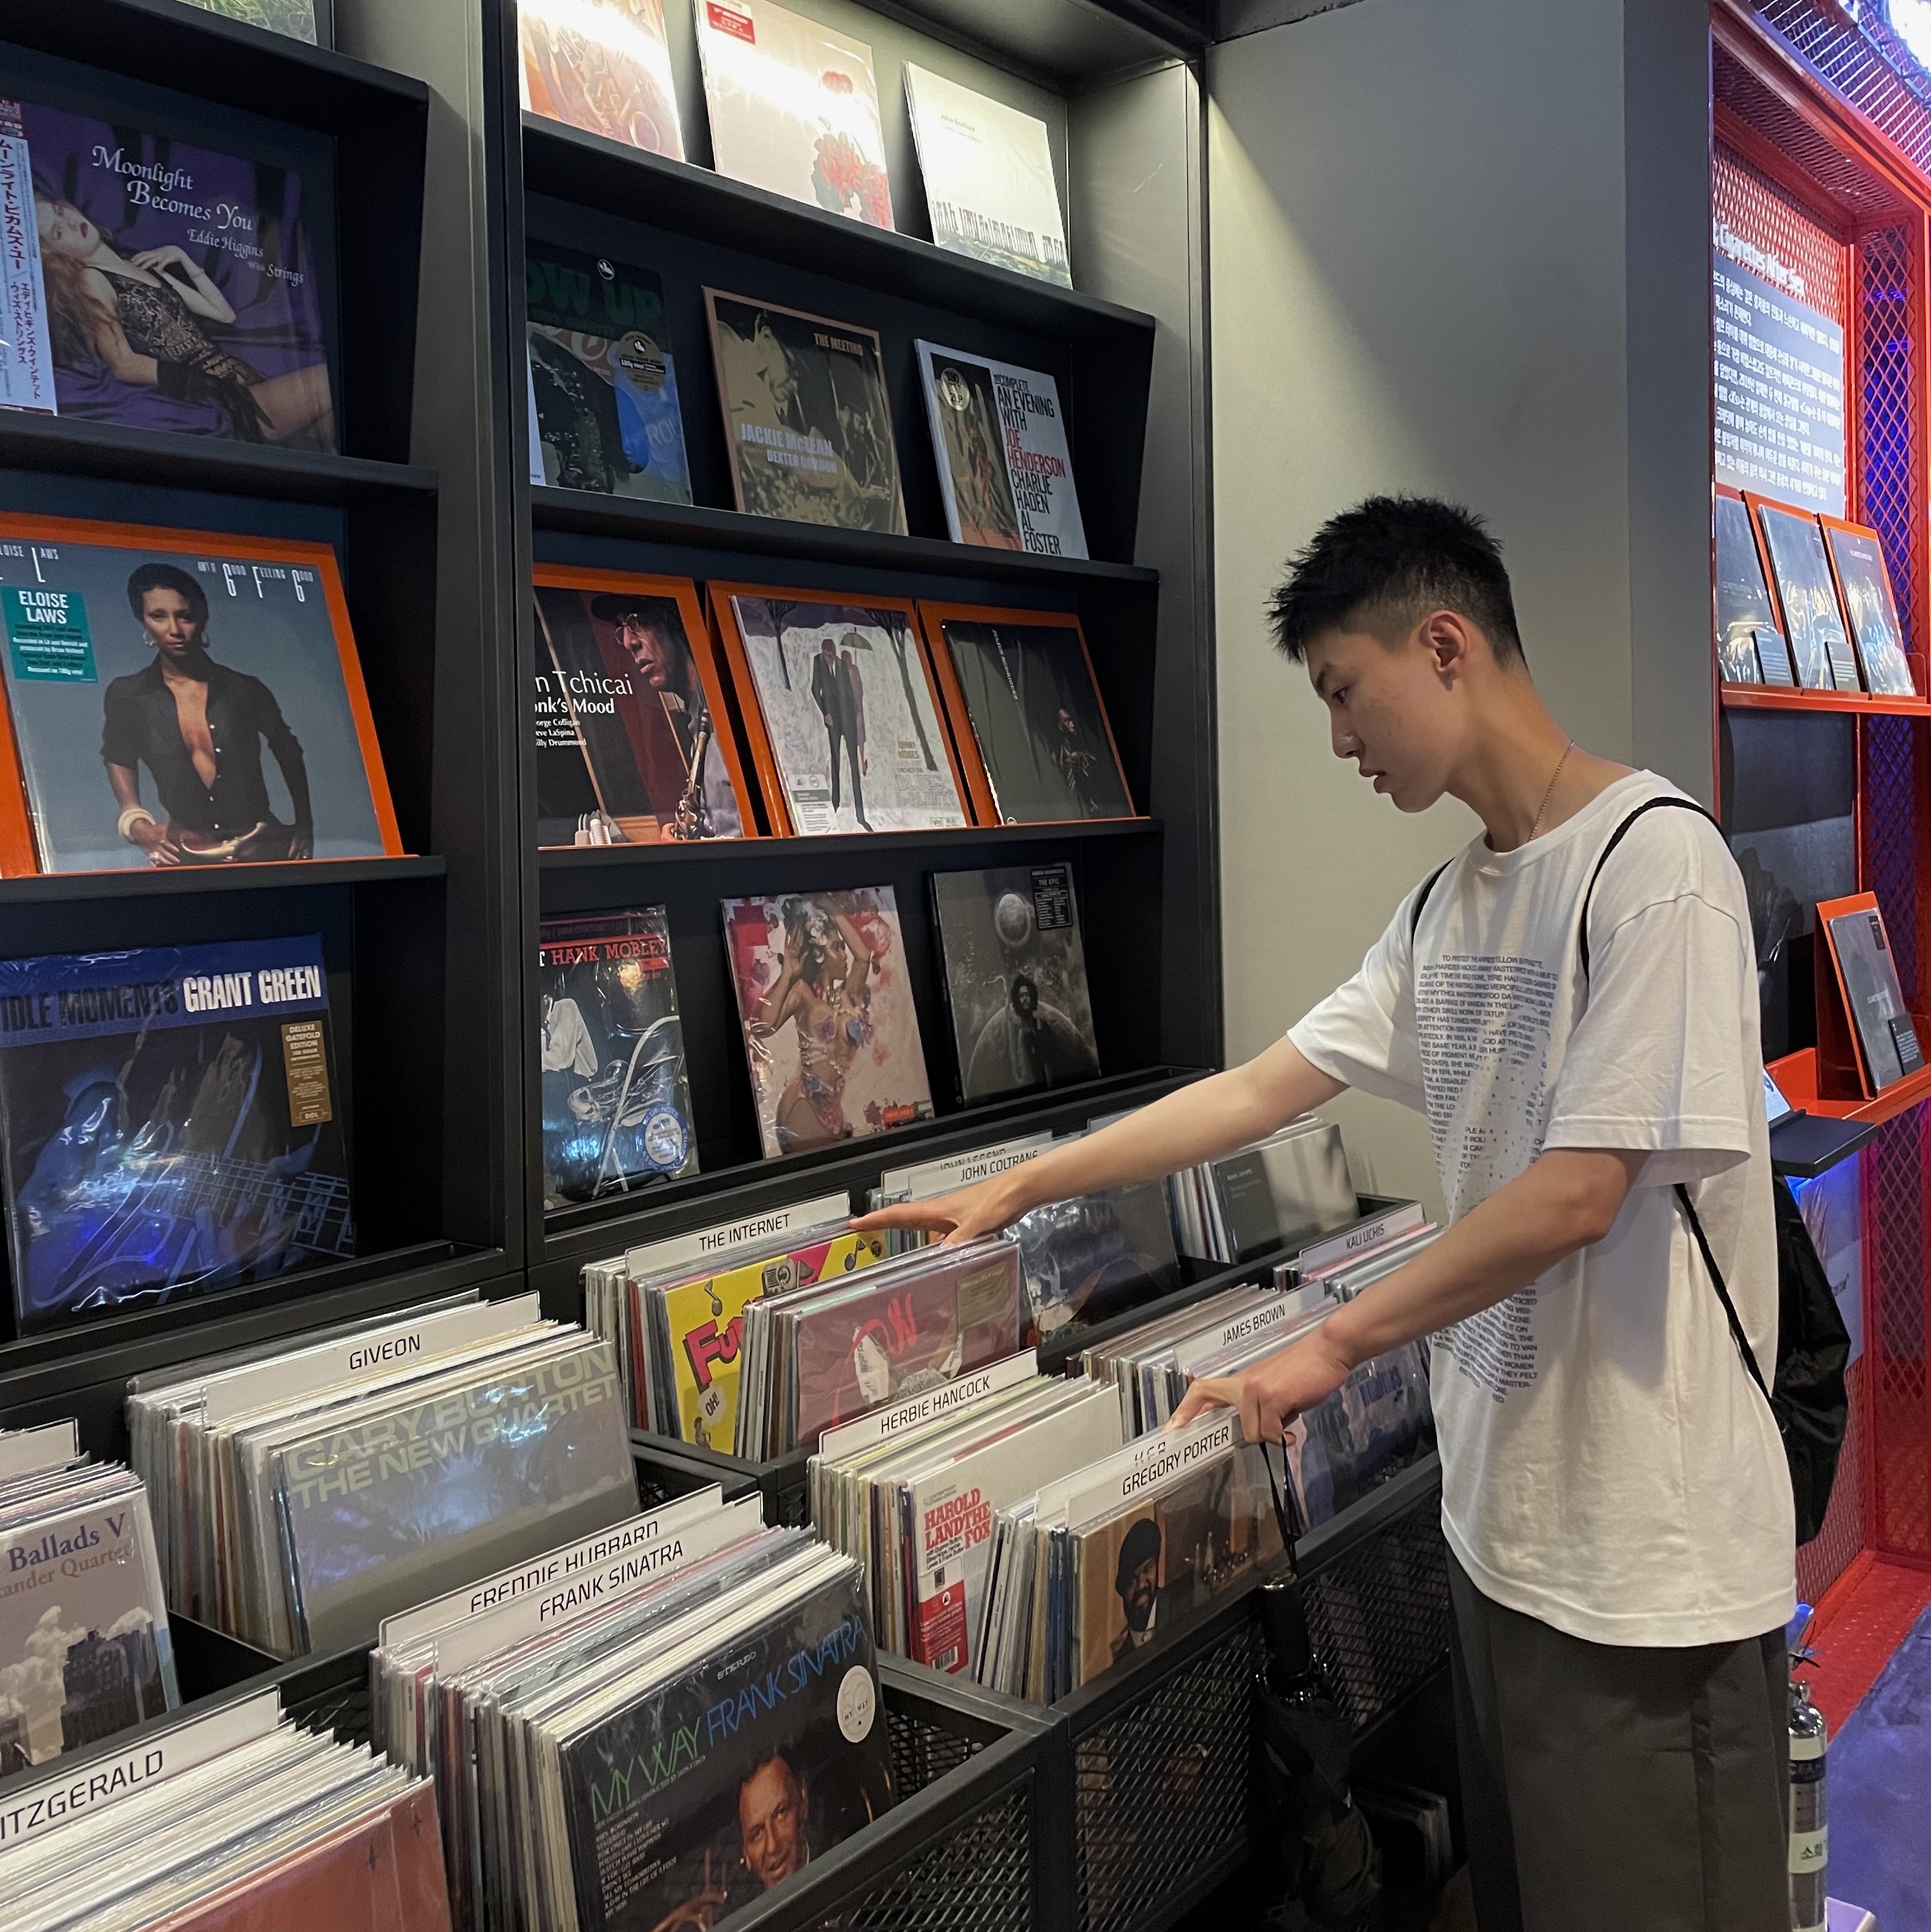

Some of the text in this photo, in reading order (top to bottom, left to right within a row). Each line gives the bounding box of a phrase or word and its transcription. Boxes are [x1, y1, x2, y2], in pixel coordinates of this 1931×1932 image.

[93, 146, 193, 192] Moonlight
[127, 180, 253, 231] Becomes You
[187, 228, 264, 259] Eddie Higgins
[266, 264, 304, 287] Strings
[814, 333, 863, 356] THE MEETING
[997, 385, 1055, 418] AN EVENING
[1001, 407, 1027, 431] WITH
[741, 423, 834, 457] JACKIE McLEAN
[1004, 427, 1022, 448] JOE
[767, 448, 838, 474] DEXTER GORDON
[1008, 450, 1066, 478] HENDERSON
[1010, 469, 1054, 496] CHARLIE
[1017, 489, 1050, 514] HADEN
[1021, 510, 1035, 531] AL
[1023, 532, 1062, 556] FOSTER
[19, 590, 69, 609] ELOISE
[26, 607, 66, 624] LAWS
[552, 670, 633, 696] Tchicai
[573, 697, 615, 714] Mood
[548, 738, 587, 747] Drummond
[551, 946, 600, 966] HANK
[604, 939, 666, 959] MOBLEY
[57, 979, 179, 1027] MOMENTS
[183, 972, 252, 1012] GRANT
[258, 965, 321, 1004] GREEN
[285, 1031, 321, 1042] GATEFOLD
[289, 1024, 315, 1033] DELUXE
[290, 1040, 318, 1050] EDITION
[661, 1106, 679, 1119] NOTE
[960, 1150, 1038, 1182] JOHN COLTRANE
[699, 1213, 790, 1252] THE INTERNET
[1345, 1223, 1385, 1250] KALI UCHIS
[1222, 1304, 1286, 1346] JAMES BROWN
[349, 1334, 421, 1371] GIVEON
[287, 1343, 616, 1481] GARY BURTON
[704, 1390, 721, 1417] OH!
[881, 1376, 990, 1435] HERBIE HANCOCK
[291, 1374, 617, 1510] THE NEW QUARTET
[1123, 1426, 1229, 1496] GREGORY PORTER
[924, 1487, 981, 1532] HAROLD
[925, 1500, 991, 1551] LAND THE
[964, 1520, 992, 1550] FOX
[6, 1512, 126, 1573] Ballads V
[61, 1543, 134, 1578] Quartet
[540, 1540, 684, 1622] FRANK SINATRA
[717, 1652, 757, 1680] STEREO
[591, 1757, 635, 1824] MY
[638, 1717, 700, 1786] WAY
[706, 1665, 787, 1748] FRANK
[787, 1615, 868, 1694] SINATRA
[0, 1749, 163, 1841] ITZGERALD
